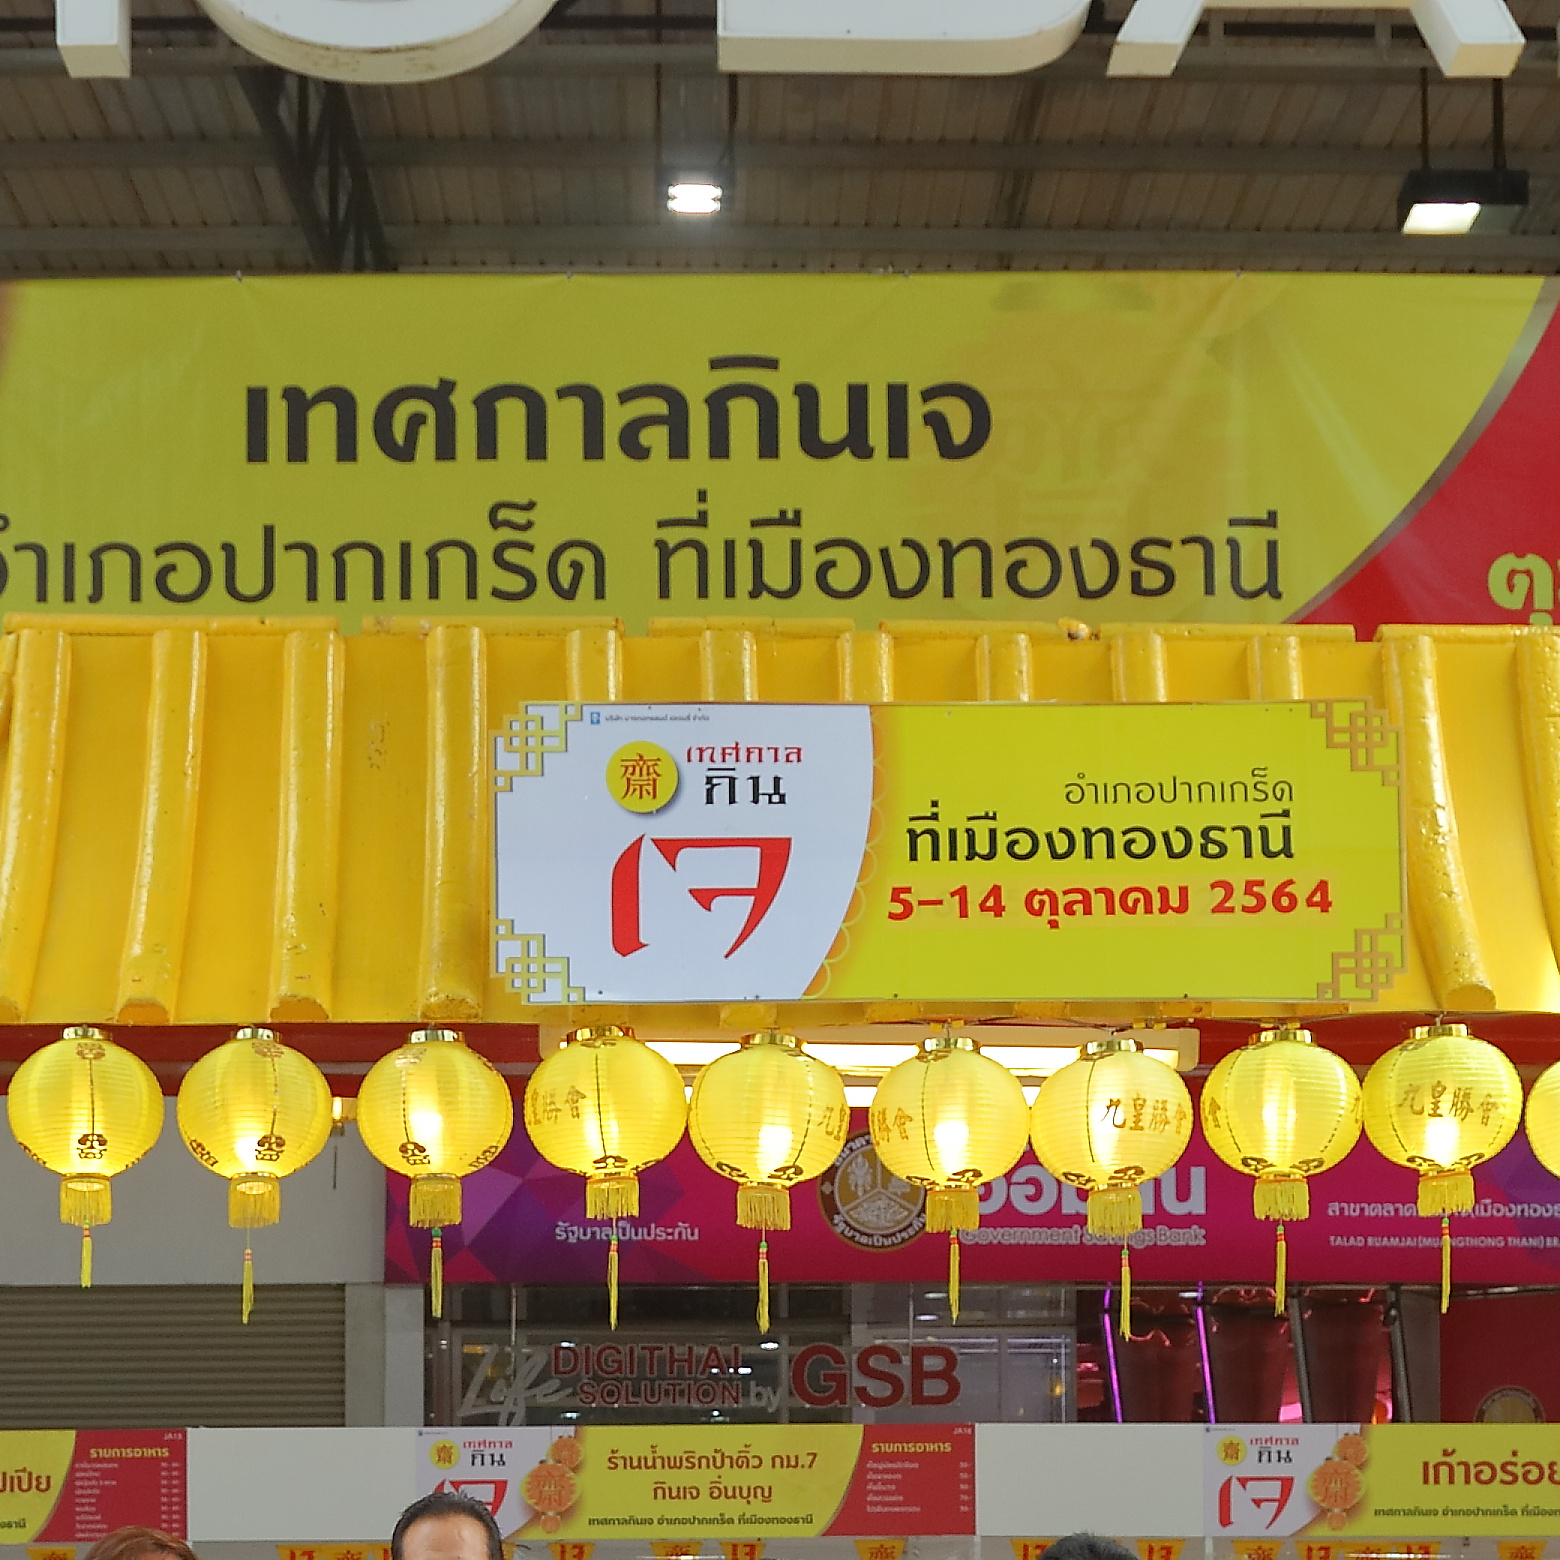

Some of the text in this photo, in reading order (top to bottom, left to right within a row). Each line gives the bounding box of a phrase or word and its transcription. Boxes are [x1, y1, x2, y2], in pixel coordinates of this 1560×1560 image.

[246, 356, 993, 463] เทศกาลกินเจ
[653, 488, 1284, 600] ที่เมืองทองธานี
[686, 741, 803, 764] เทศกาล
[619, 753, 662, 801] 齋
[704, 768, 788, 806] กิน
[1065, 766, 1294, 806] อำเภอปากเกร็ด
[906, 800, 1295, 862] ที่เมืองทองธานี
[611, 833, 793, 960] เจ
[1024, 884, 1190, 930] ตุลาคม
[1209, 878, 1333, 915] 2564
[1101, 1093, 1188, 1136] 九皇勝會
[1397, 1080, 1499, 1127] 九皇勝會
[554, 1220, 700, 1243] รัฐบาลเป็นประกัน
[1156, 1225, 1207, 1246] Bank
[578, 1342, 962, 1413] SOLUTION by GSB
[470, 1449, 507, 1468] กิน
[770, 1451, 818, 1470] กม.7
[871, 1442, 953, 1454] รายการอาหาร
[1257, 1446, 1294, 1465] กิน
[653, 1480, 701, 1501] กินเจ
[1217, 1475, 1294, 1529] เจ
